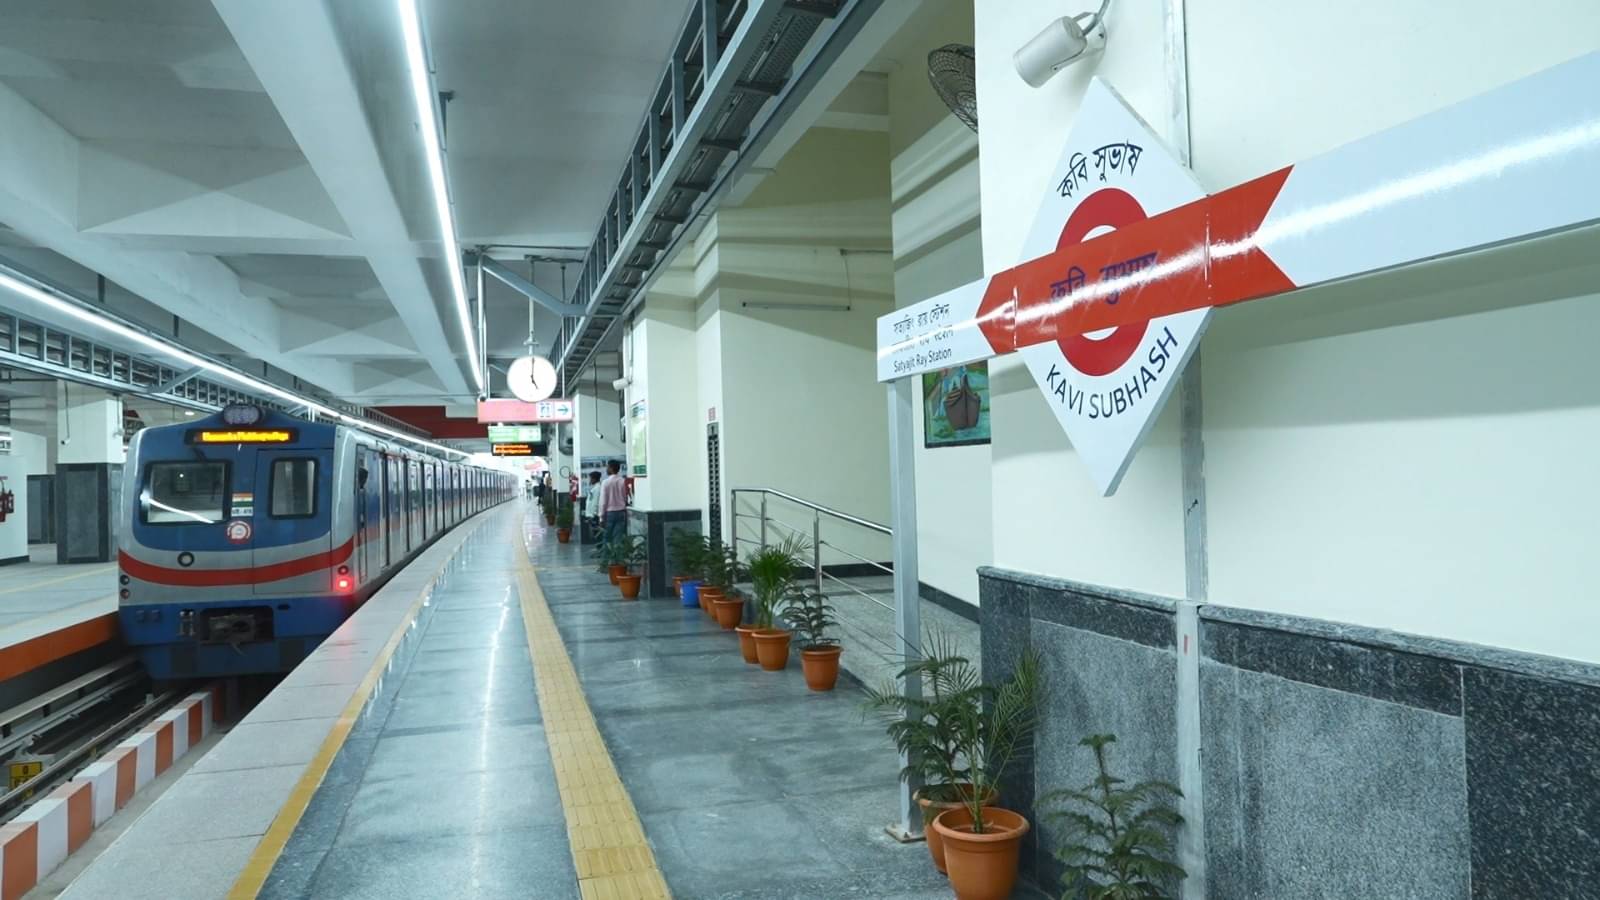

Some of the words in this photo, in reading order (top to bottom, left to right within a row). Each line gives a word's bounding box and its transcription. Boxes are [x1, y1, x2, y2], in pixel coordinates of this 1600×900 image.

[1056, 152, 1089, 198] কবি
[1093, 139, 1143, 182] সুভাষ
[893, 358, 915, 374] Satyajit
[916, 353, 927, 367] Ray
[928, 348, 952, 363] Station
[1046, 363, 1084, 415] KAVI
[1088, 326, 1179, 419] SUBHASH
